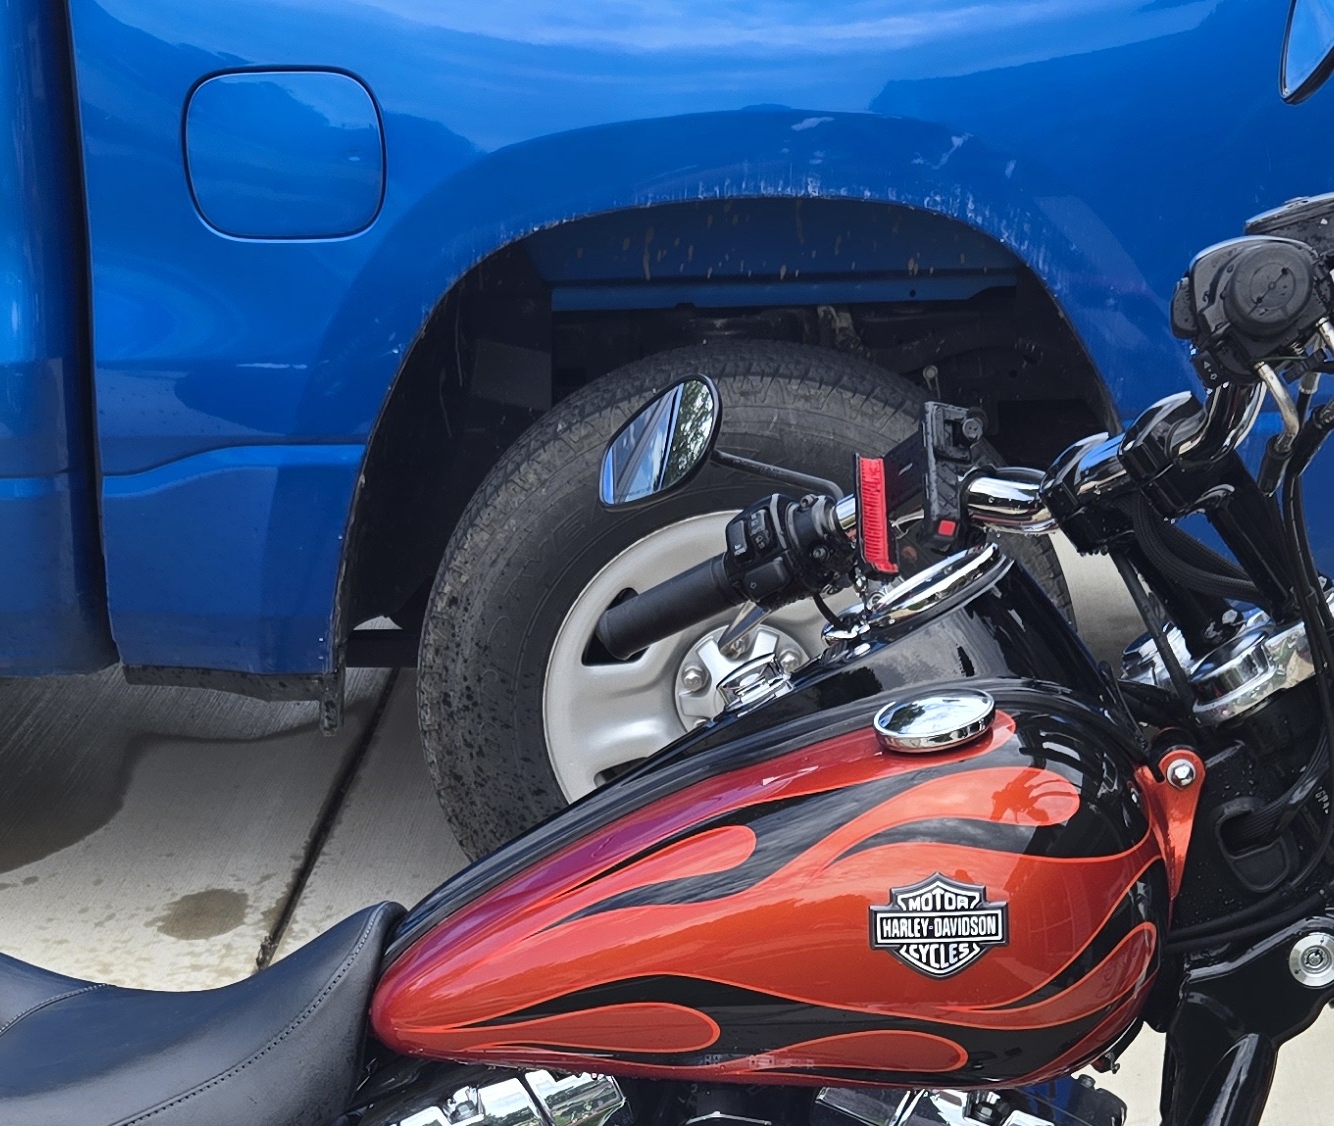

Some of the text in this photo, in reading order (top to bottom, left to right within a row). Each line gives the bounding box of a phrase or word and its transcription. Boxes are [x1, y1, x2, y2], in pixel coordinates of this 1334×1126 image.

[908, 887, 969, 911] MOTOR
[882, 915, 996, 938] HARLEY-DAVIDSON
[909, 943, 969, 969] CYCLES
